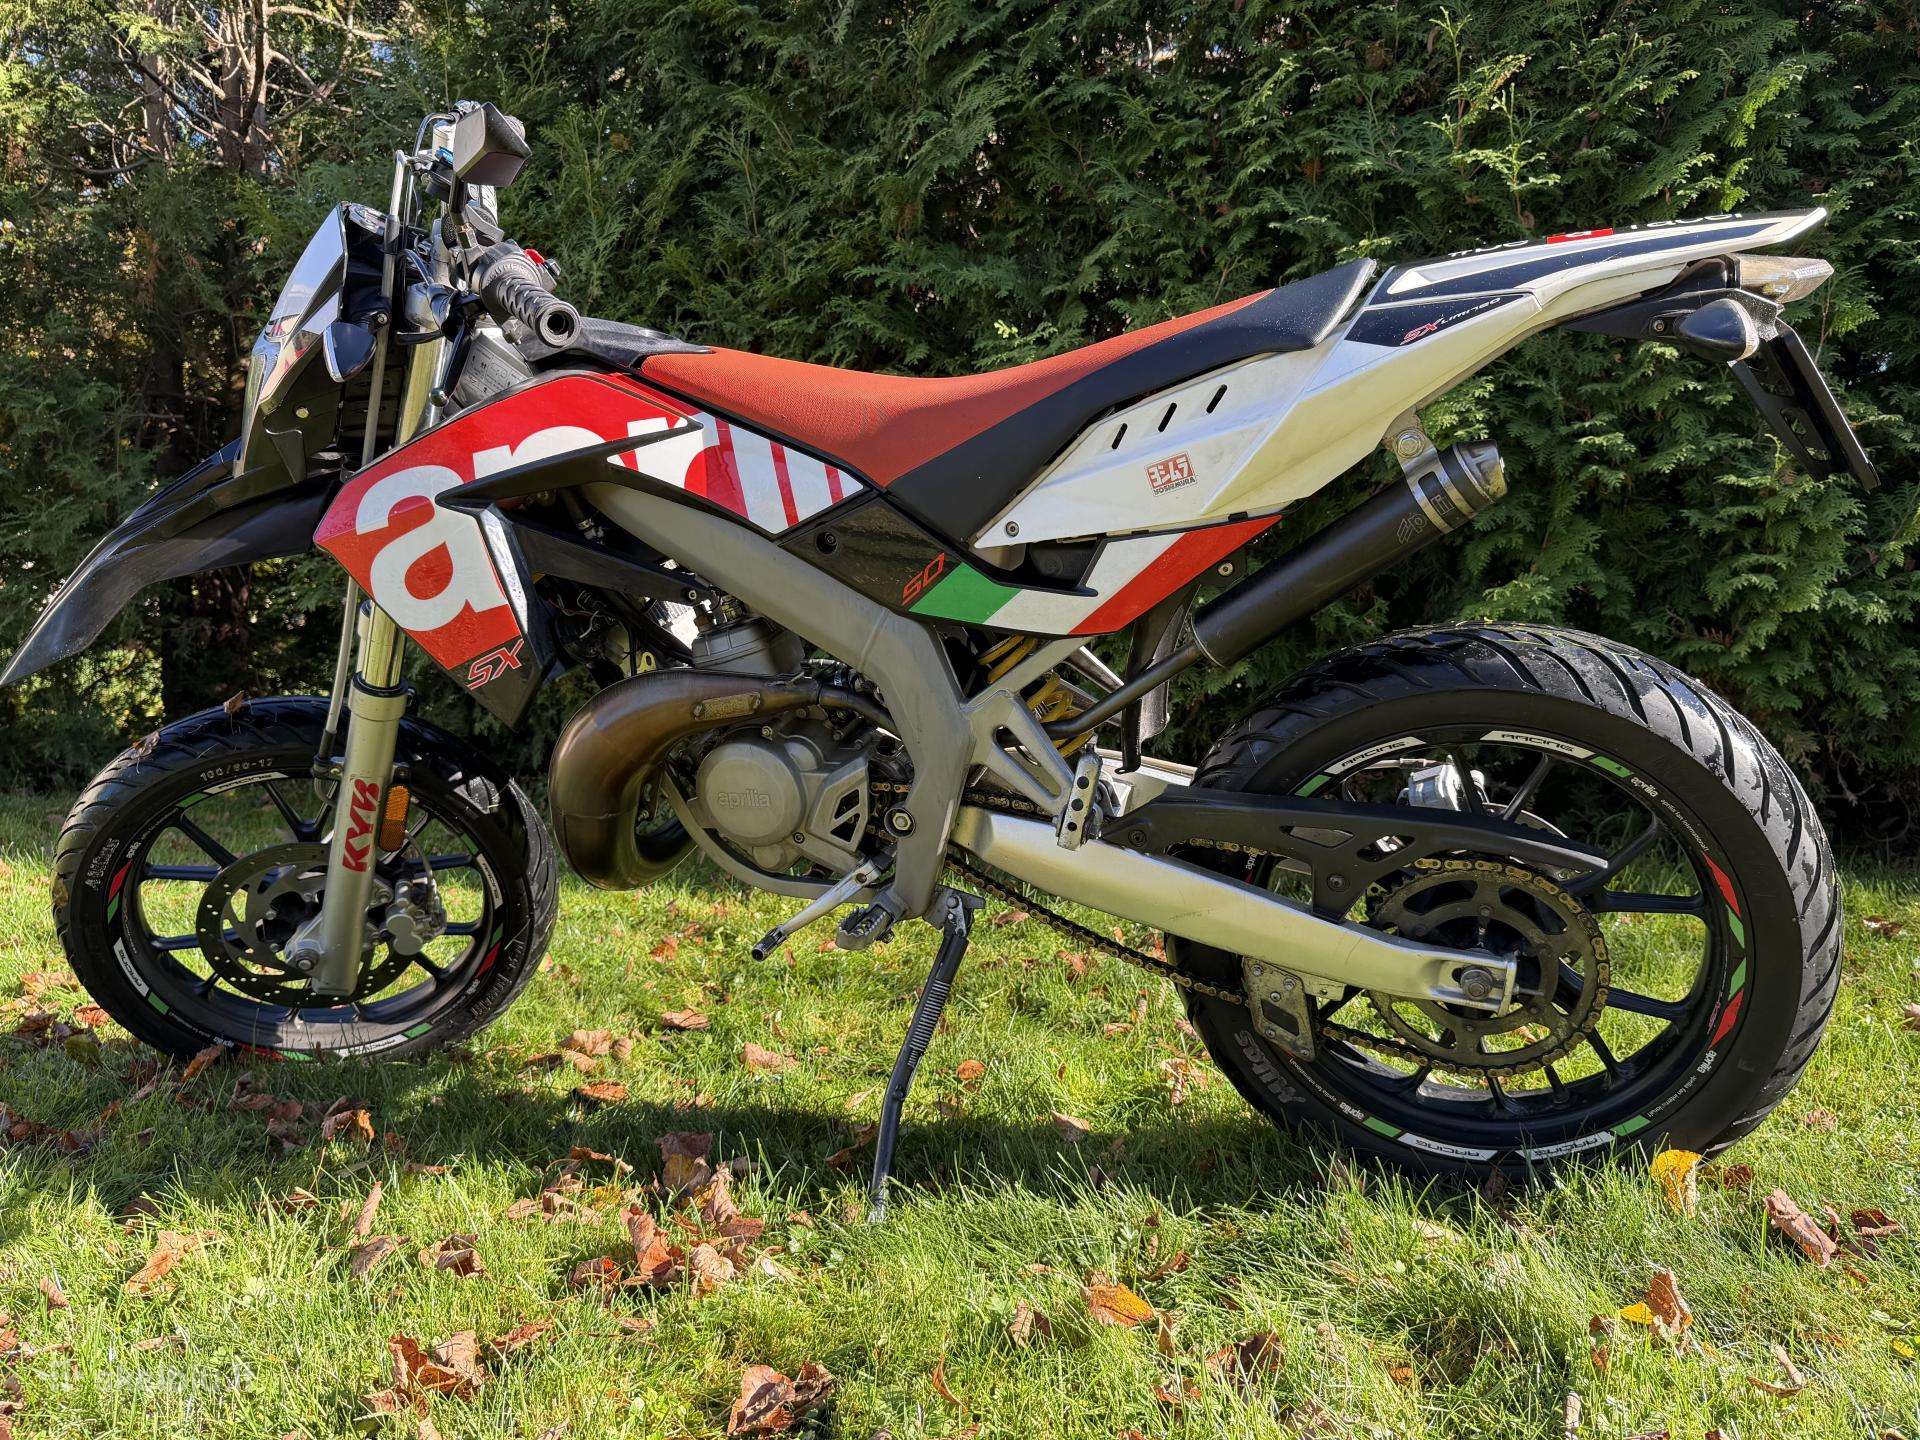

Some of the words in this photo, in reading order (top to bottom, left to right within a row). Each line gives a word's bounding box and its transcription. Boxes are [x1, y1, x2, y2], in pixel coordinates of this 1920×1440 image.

[901, 552, 945, 607] 50
[465, 637, 525, 690] SX
[717, 788, 772, 809] aprilia
[1631, 777, 1659, 797] aprilia
[342, 778, 380, 873] KYB
[1697, 1050, 1717, 1074] aprilia
[1339, 1101, 1365, 1120] aprilia
